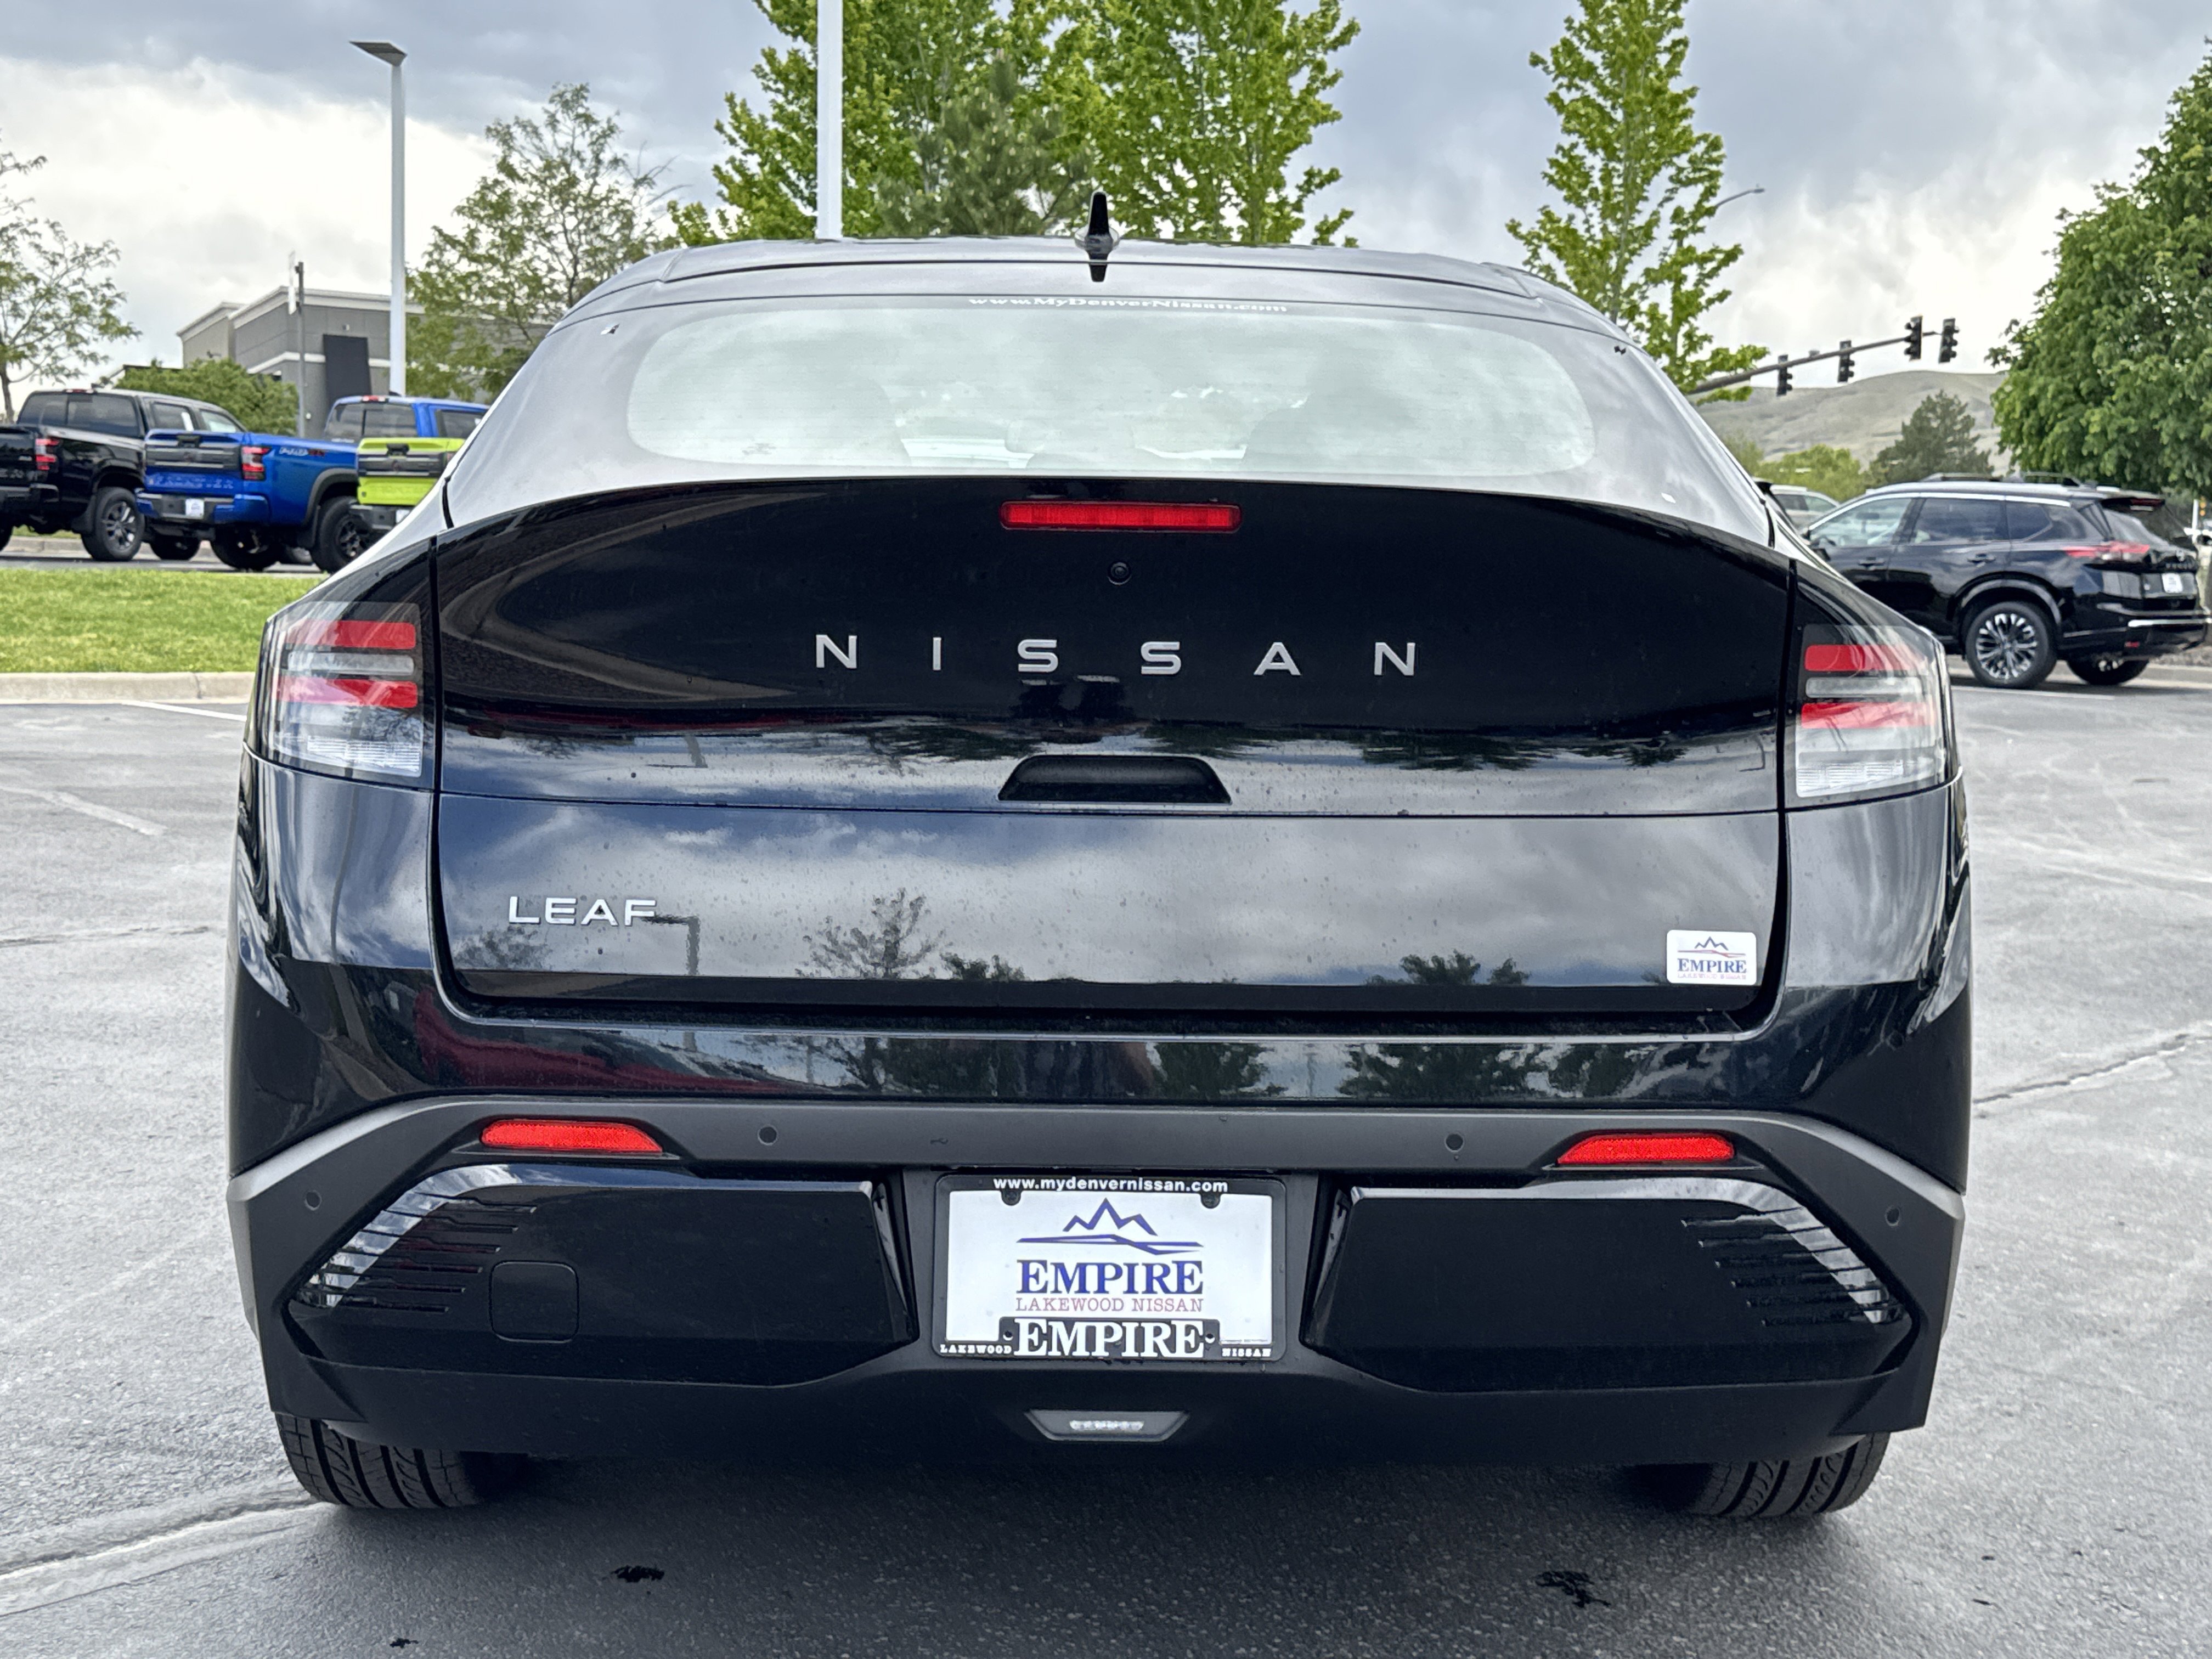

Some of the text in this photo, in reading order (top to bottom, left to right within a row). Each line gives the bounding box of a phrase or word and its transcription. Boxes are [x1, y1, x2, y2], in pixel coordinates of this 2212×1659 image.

[969, 298, 1287, 312] www.MyDenverNissan.com
[815, 634, 1416, 676] NISSAN
[509, 896, 656, 926] LEAF
[1677, 958, 1747, 973] EMPIRE
[994, 1177, 1228, 1193] www.mydenvernissan.com
[1016, 1259, 1204, 1295] EMPIRE
[1015, 1297, 1204, 1313] LAKEWOOD NISSAN
[1014, 1317, 1204, 1358] EMPIRE
[940, 1344, 1012, 1355] LAKEWOOD
[1222, 1347, 1272, 1357] NISSAN
